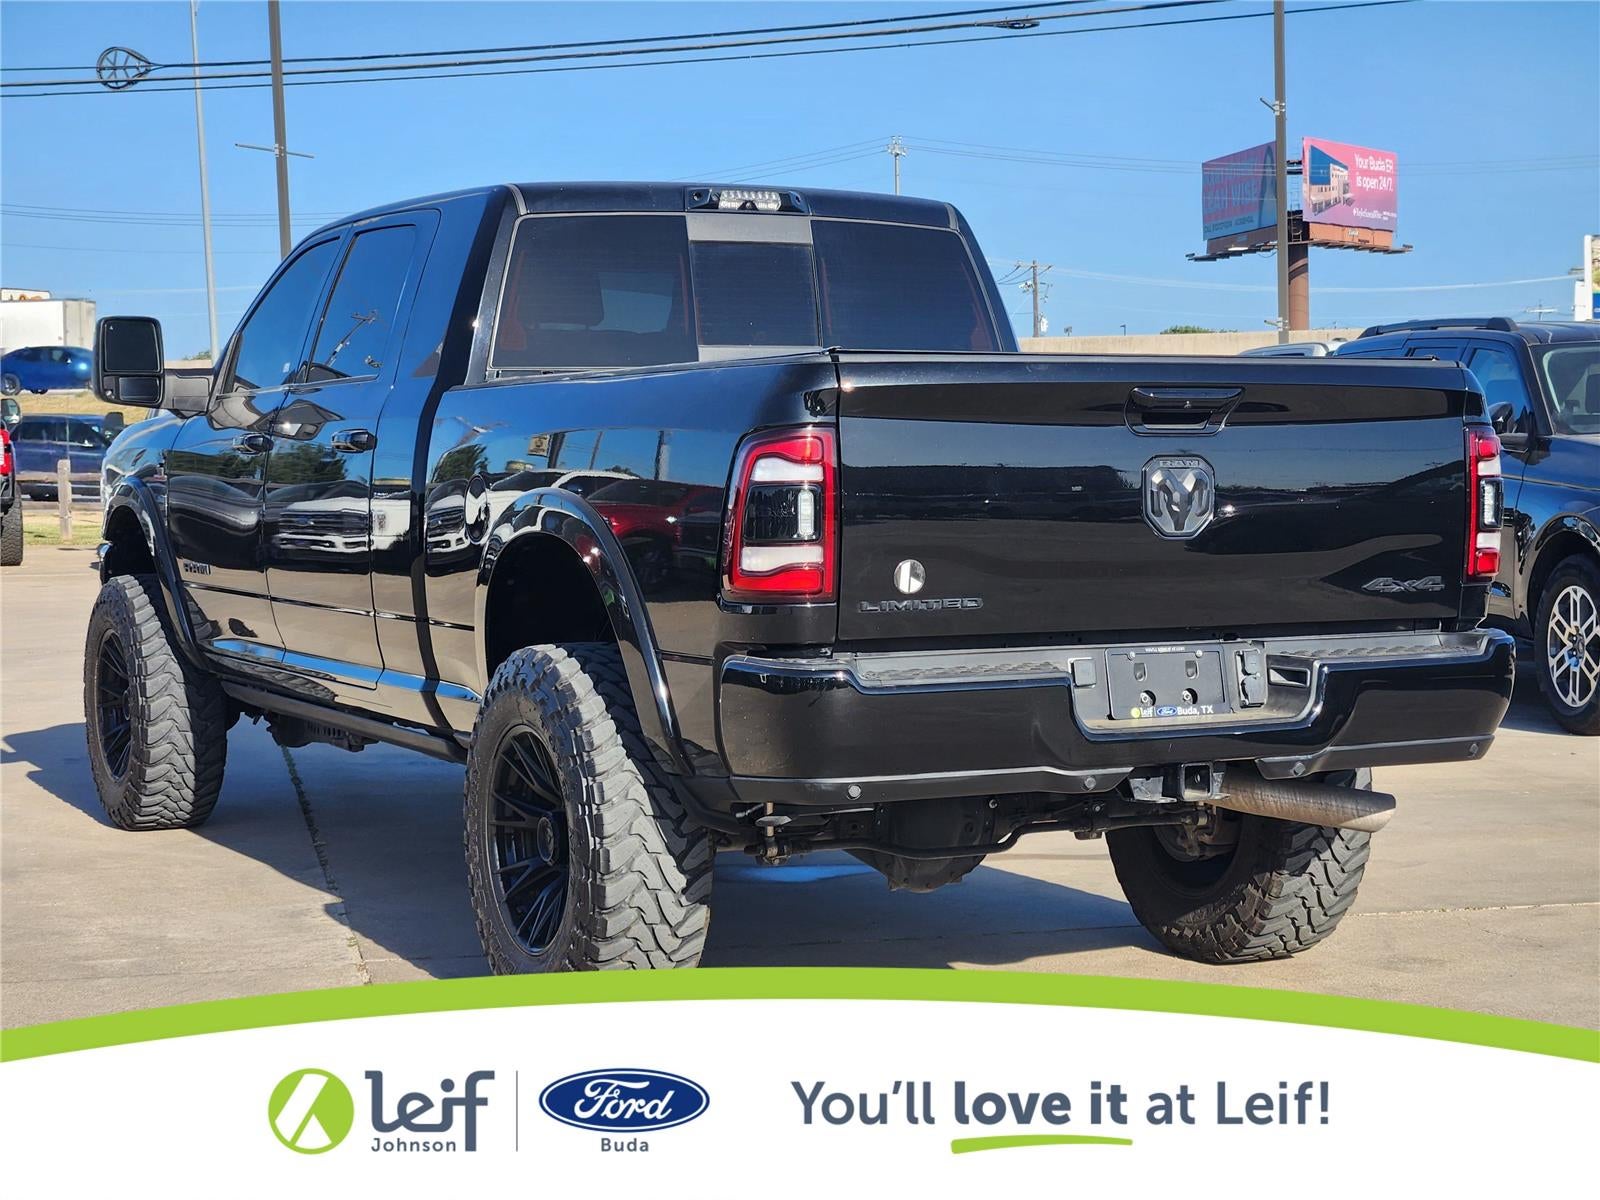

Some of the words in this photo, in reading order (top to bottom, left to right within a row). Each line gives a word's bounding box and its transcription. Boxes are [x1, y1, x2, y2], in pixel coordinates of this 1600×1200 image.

[1354, 153, 1368, 168] Your
[1355, 172, 1362, 187] is
[1362, 176, 1378, 191] open
[1160, 460, 1199, 468] RAM
[858, 598, 984, 613] LIMITED
[1177, 705, 1199, 715] Buda,
[1201, 705, 1214, 714] TX
